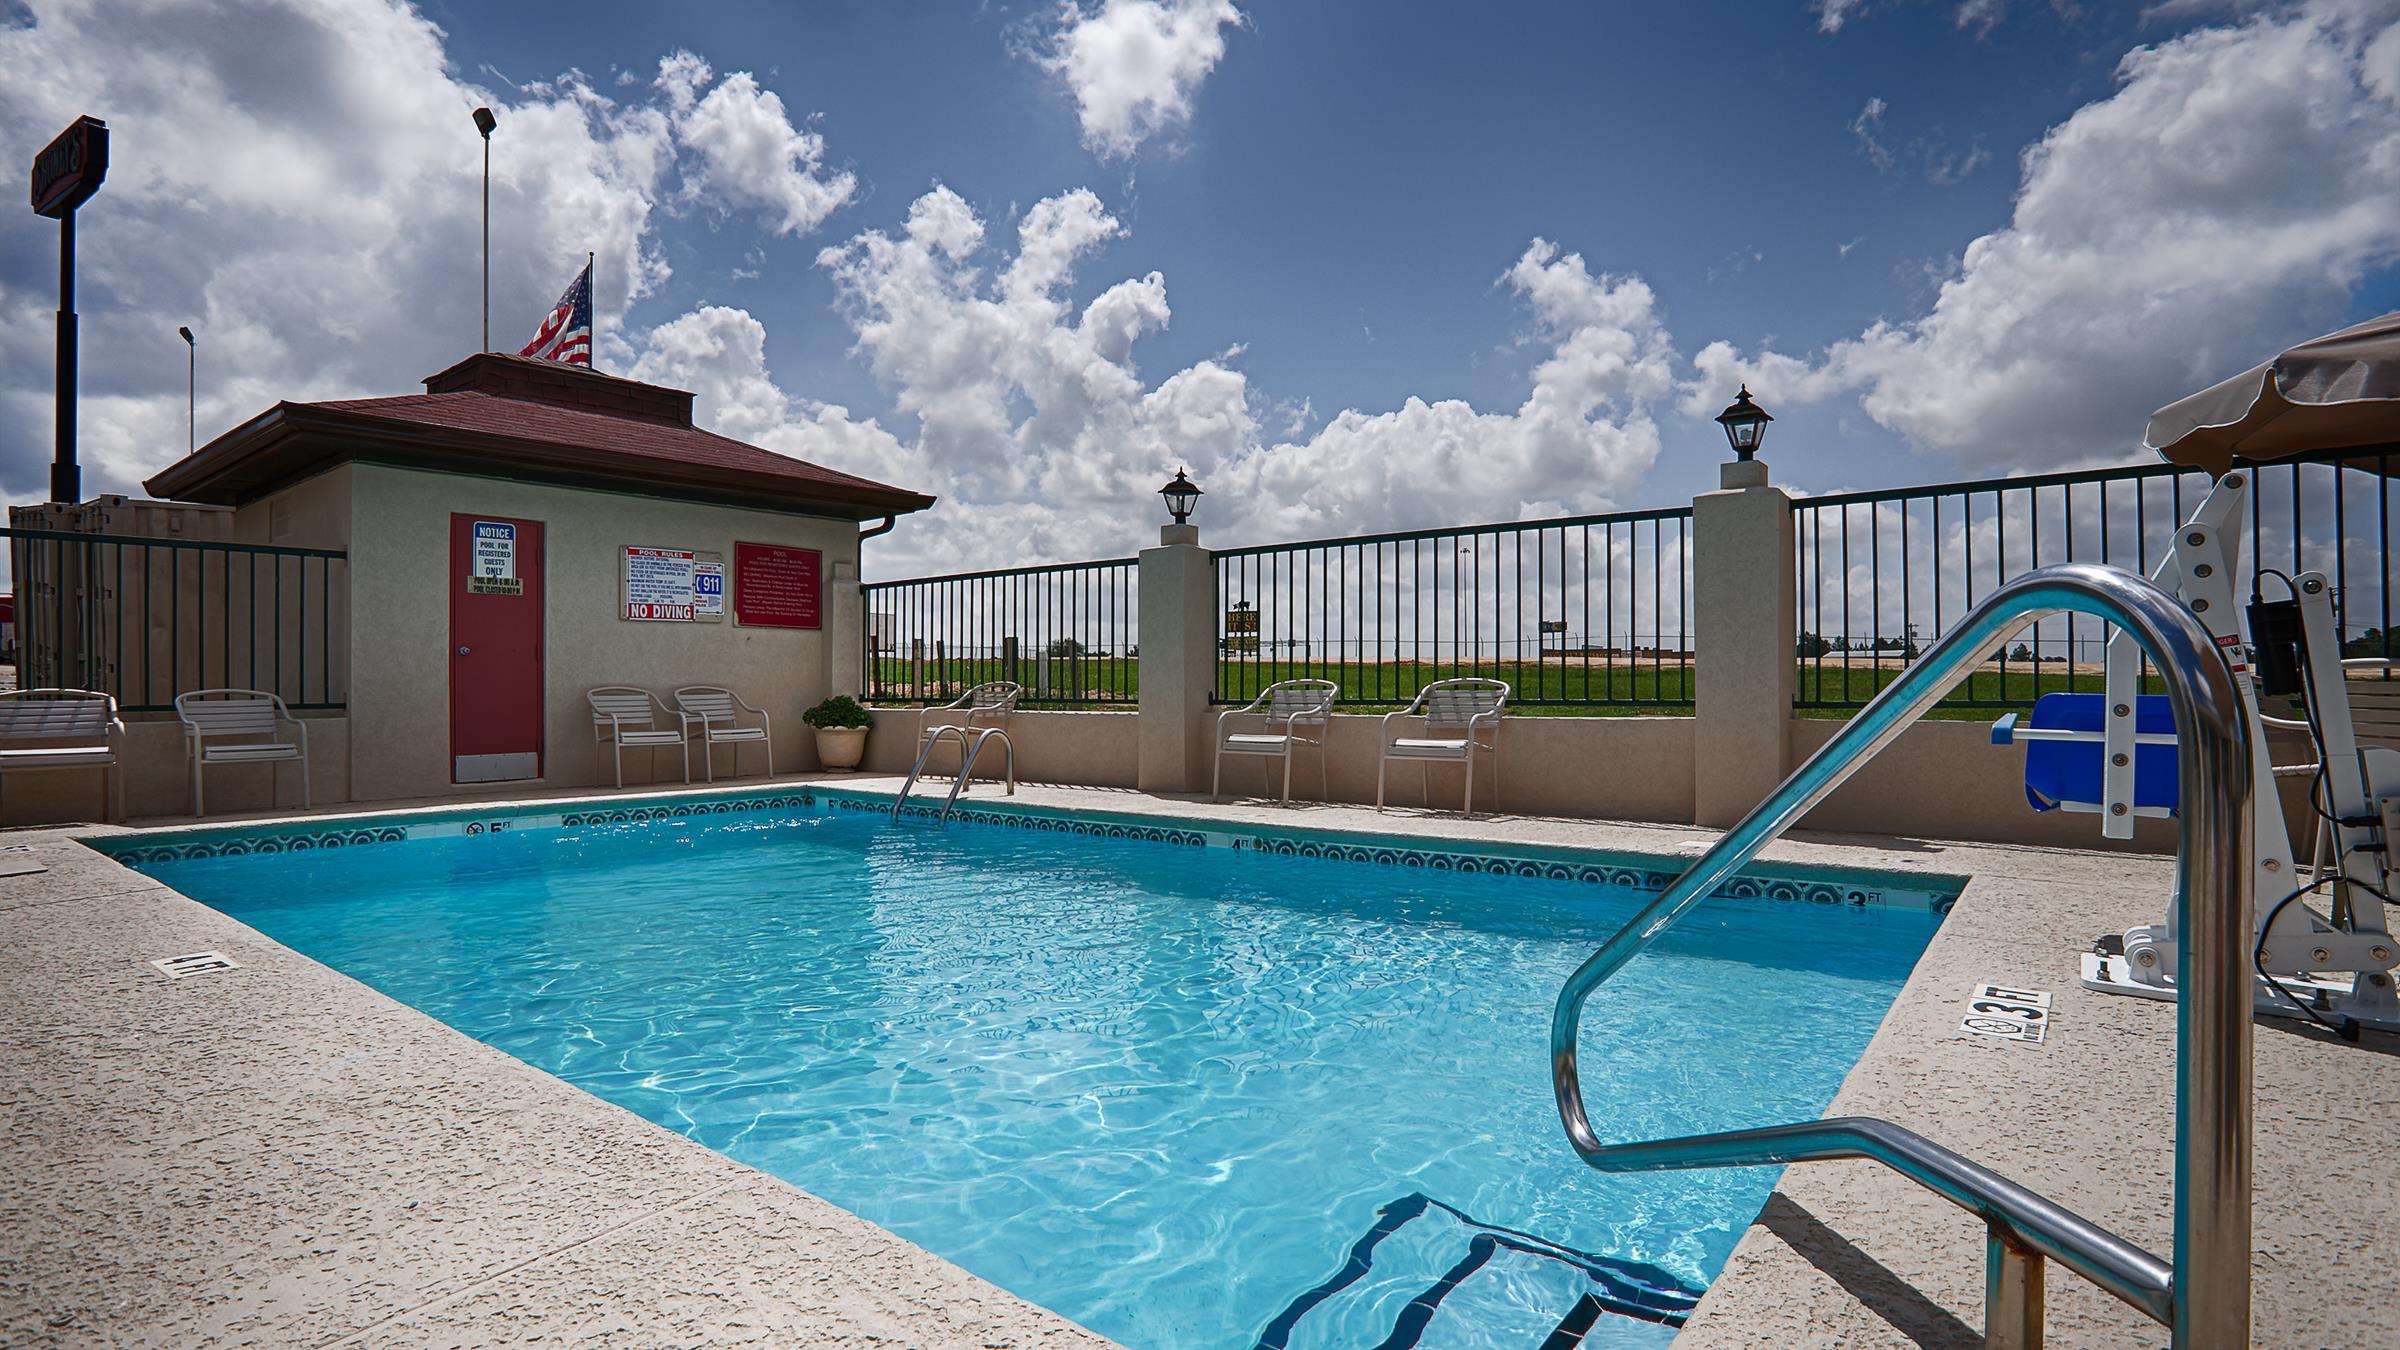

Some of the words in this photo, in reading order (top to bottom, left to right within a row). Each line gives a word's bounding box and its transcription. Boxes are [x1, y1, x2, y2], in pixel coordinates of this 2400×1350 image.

[479, 527, 510, 539] NOTICE
[480, 541, 495, 549] POOL
[498, 542, 509, 550] FOR
[478, 549, 512, 558] REGISTERED
[484, 558, 505, 566] GUESTS
[485, 566, 504, 576] ONLY
[703, 576, 720, 592] 911
[630, 604, 648, 618] NO
[652, 605, 692, 619] DIVING
[1984, 986, 2039, 1003] FT
